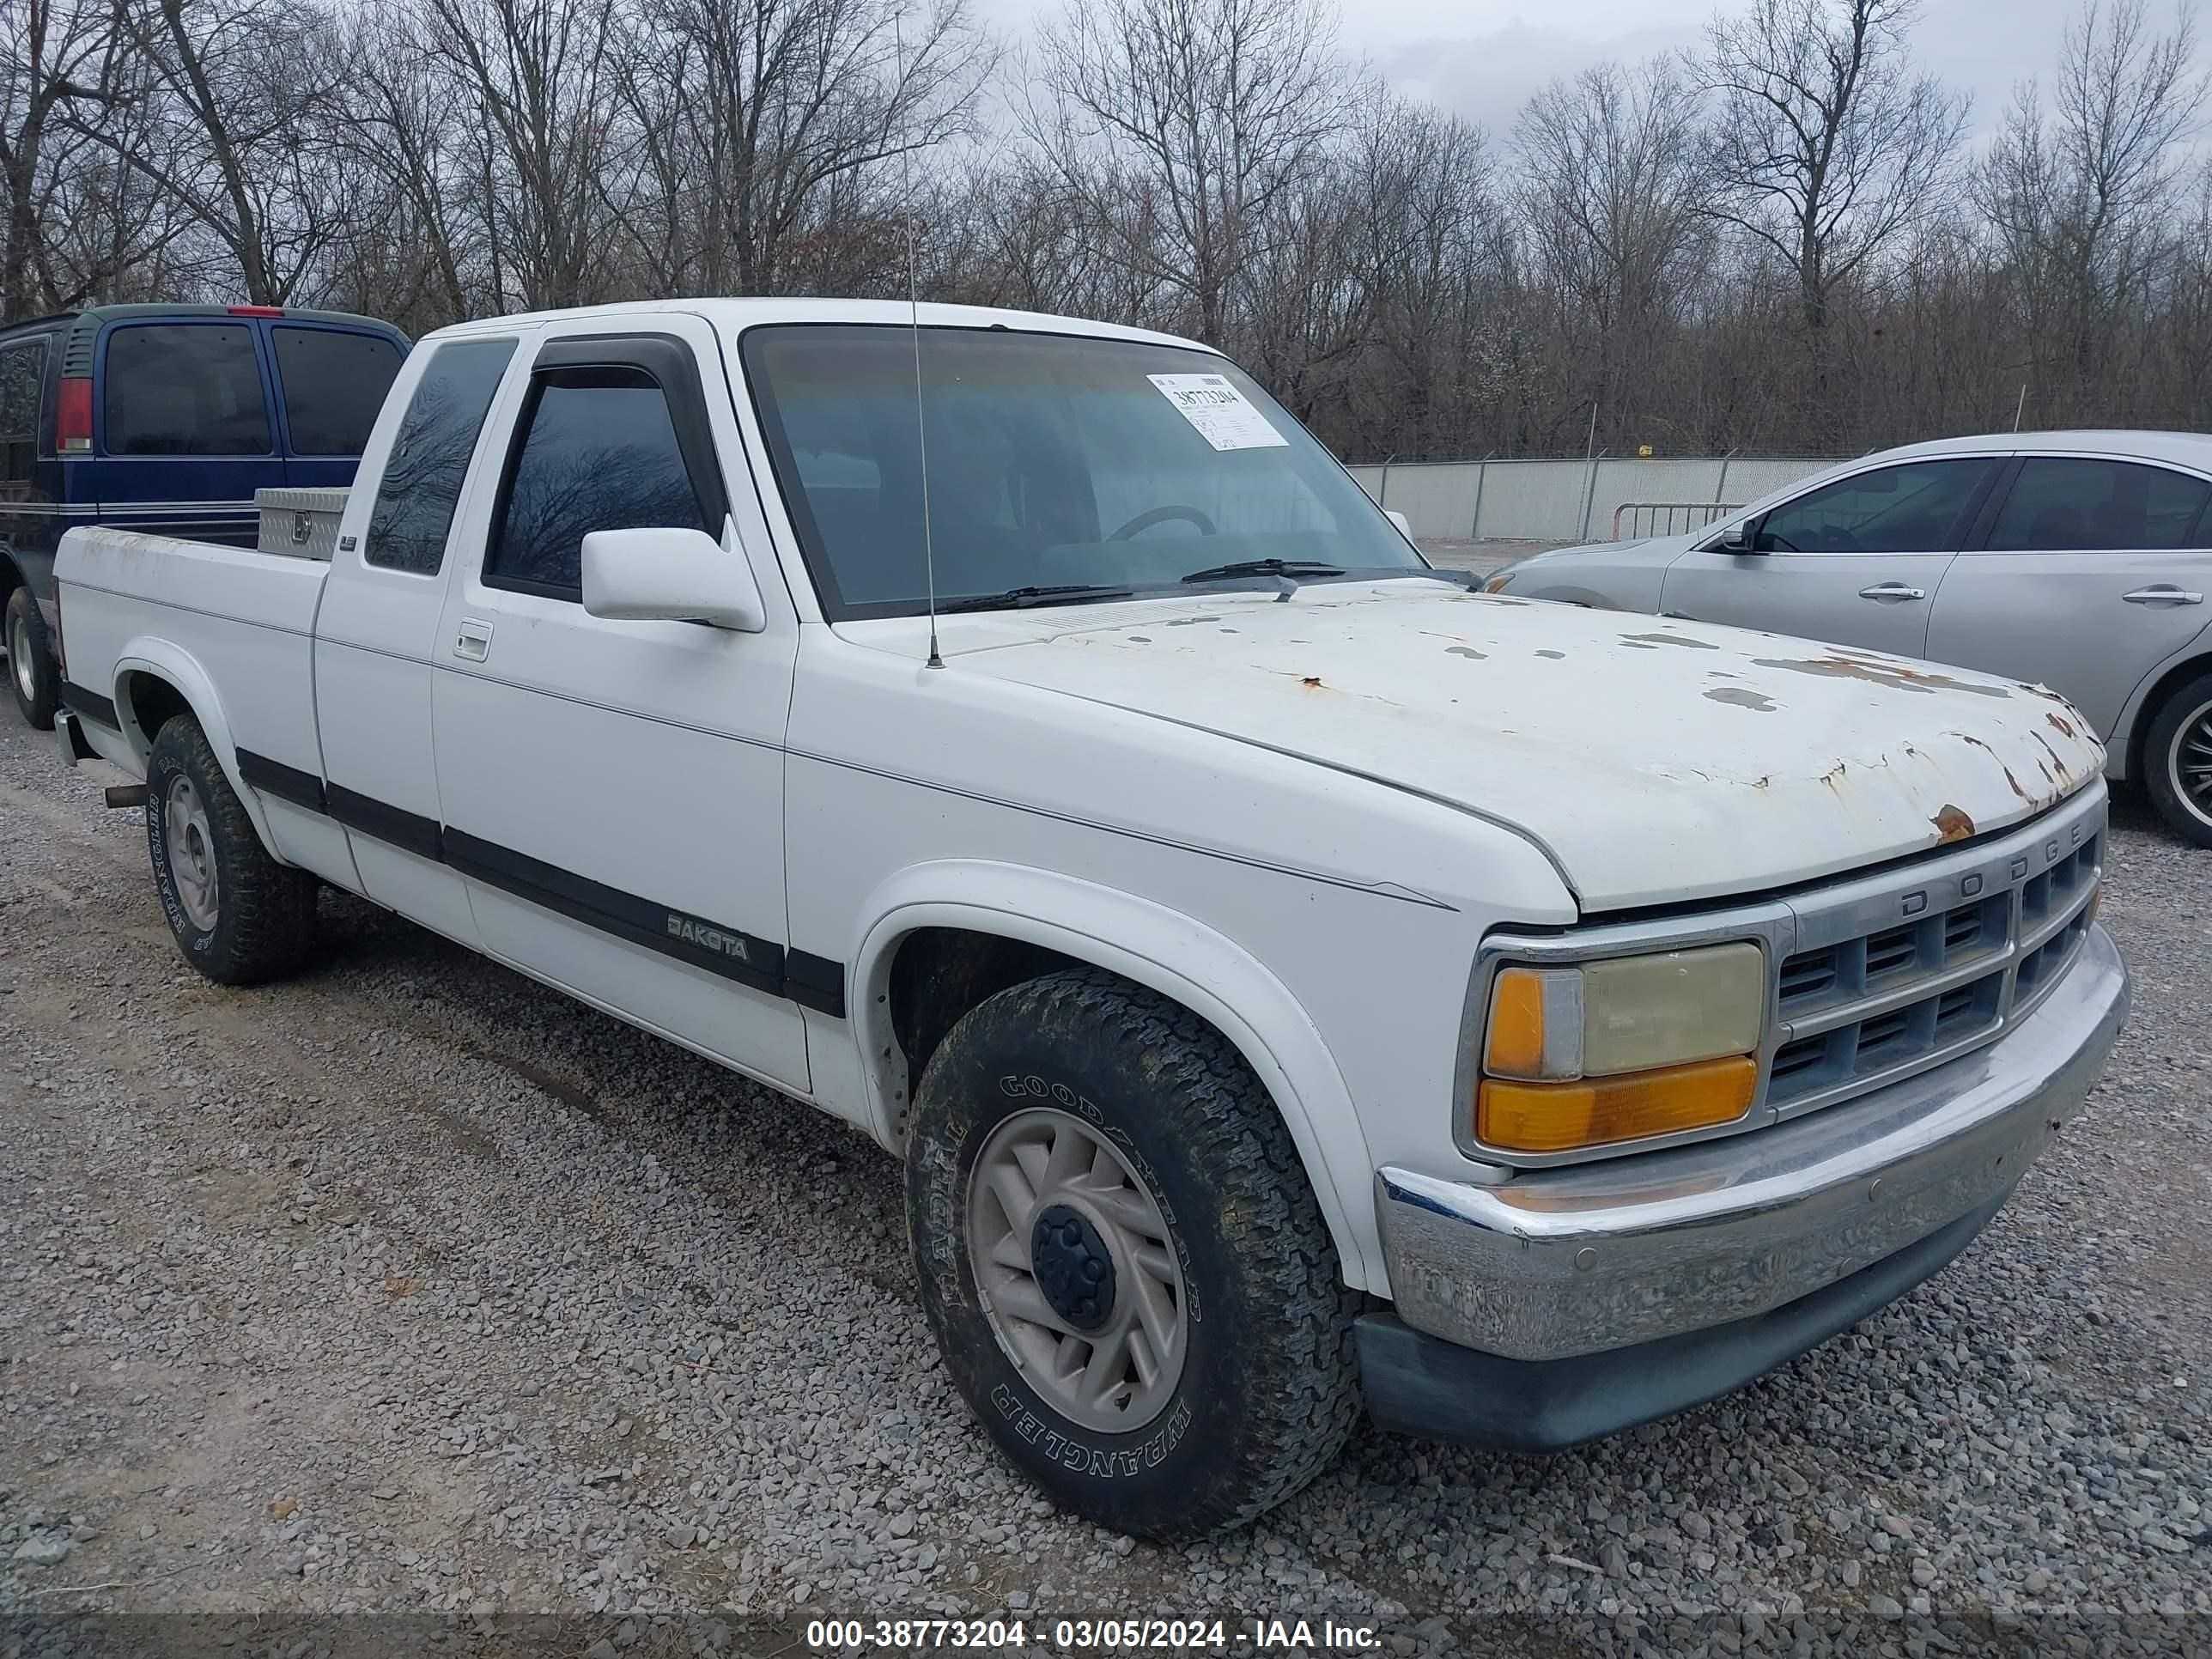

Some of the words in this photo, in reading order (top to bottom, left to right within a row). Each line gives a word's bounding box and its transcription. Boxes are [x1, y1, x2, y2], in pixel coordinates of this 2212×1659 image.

[1173, 391, 1239, 405] 38773204
[1901, 824, 2082, 917] DODGE
[667, 914, 749, 960] DAKOTA
[990, 1385, 1194, 1478] WRANGLER
